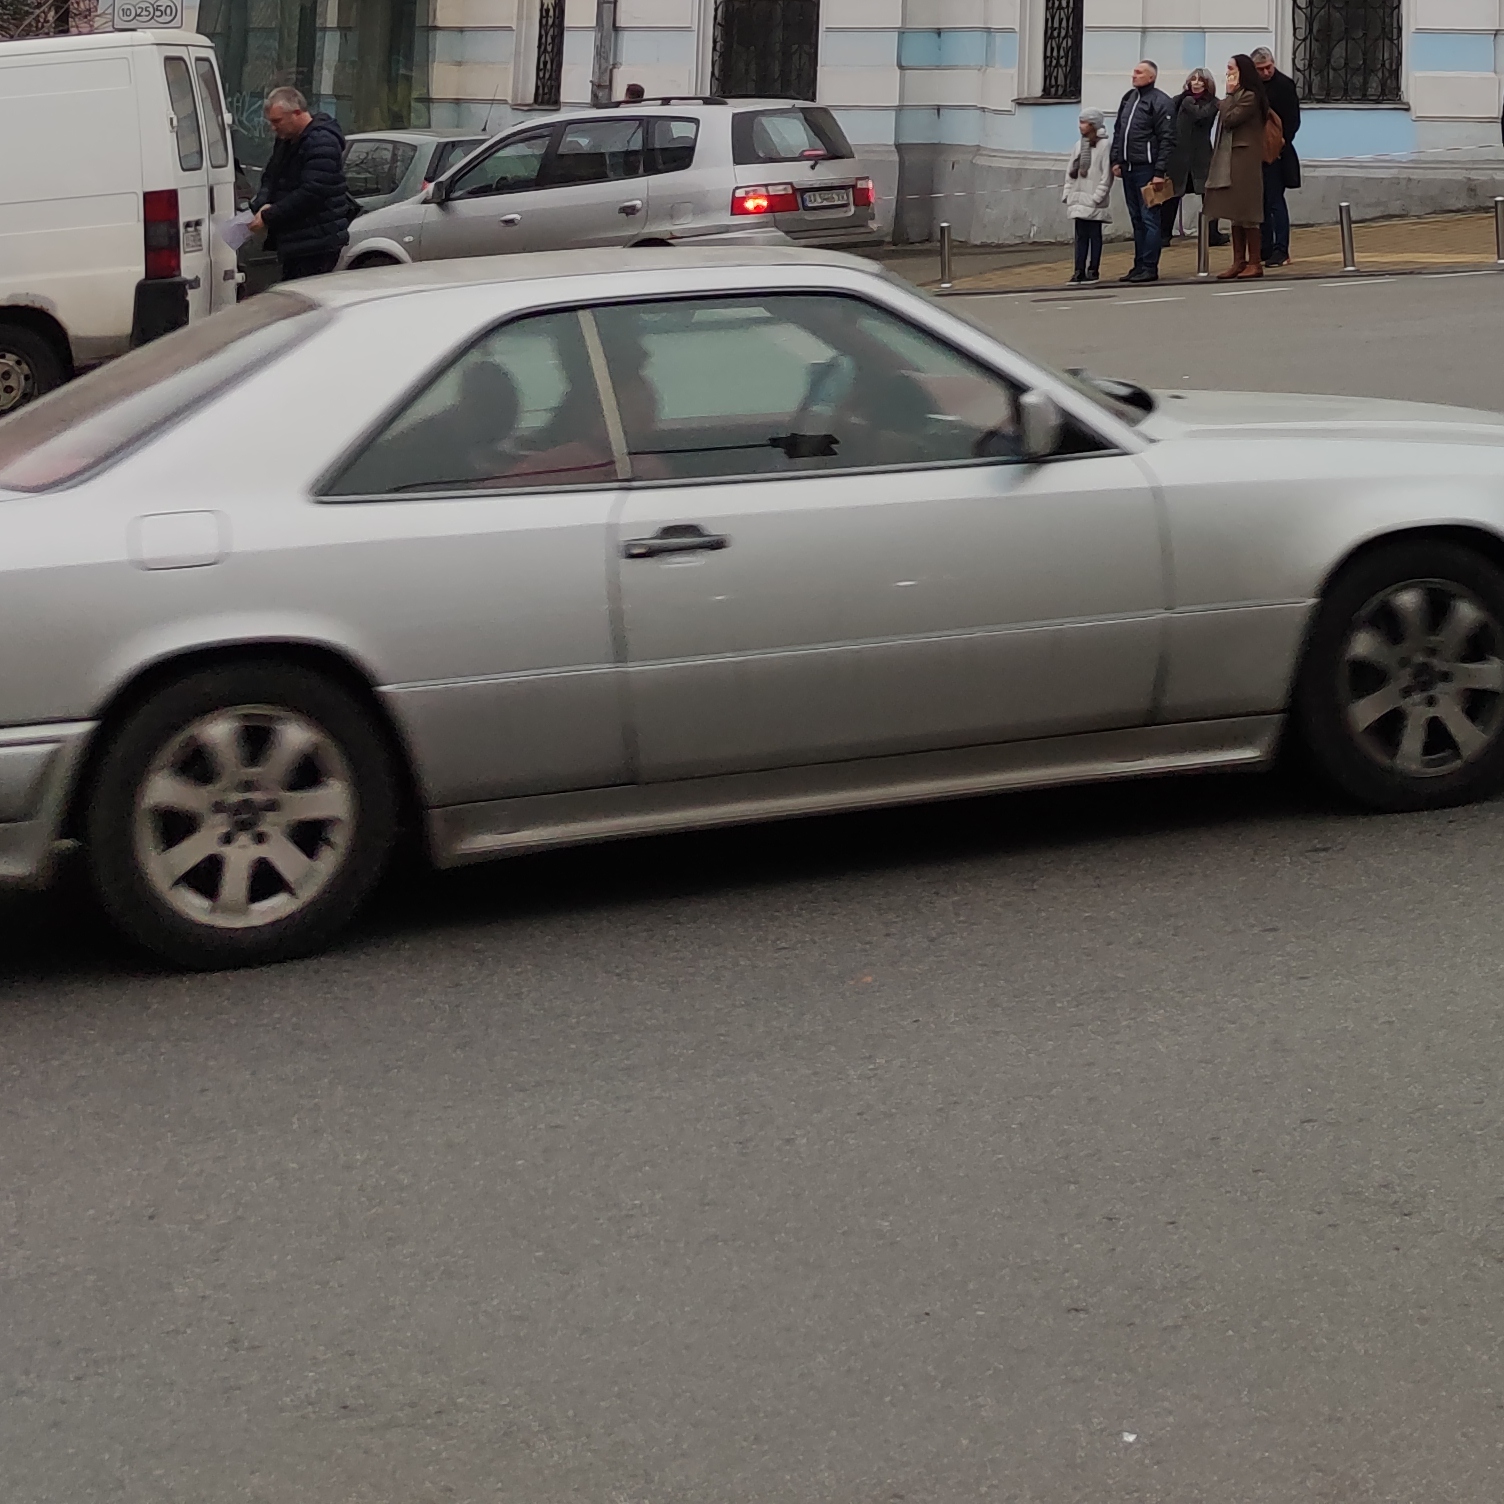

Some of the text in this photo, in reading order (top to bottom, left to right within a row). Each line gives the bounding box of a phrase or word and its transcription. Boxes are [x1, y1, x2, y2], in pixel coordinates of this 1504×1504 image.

[121, 5, 173, 18] 10 25 50
